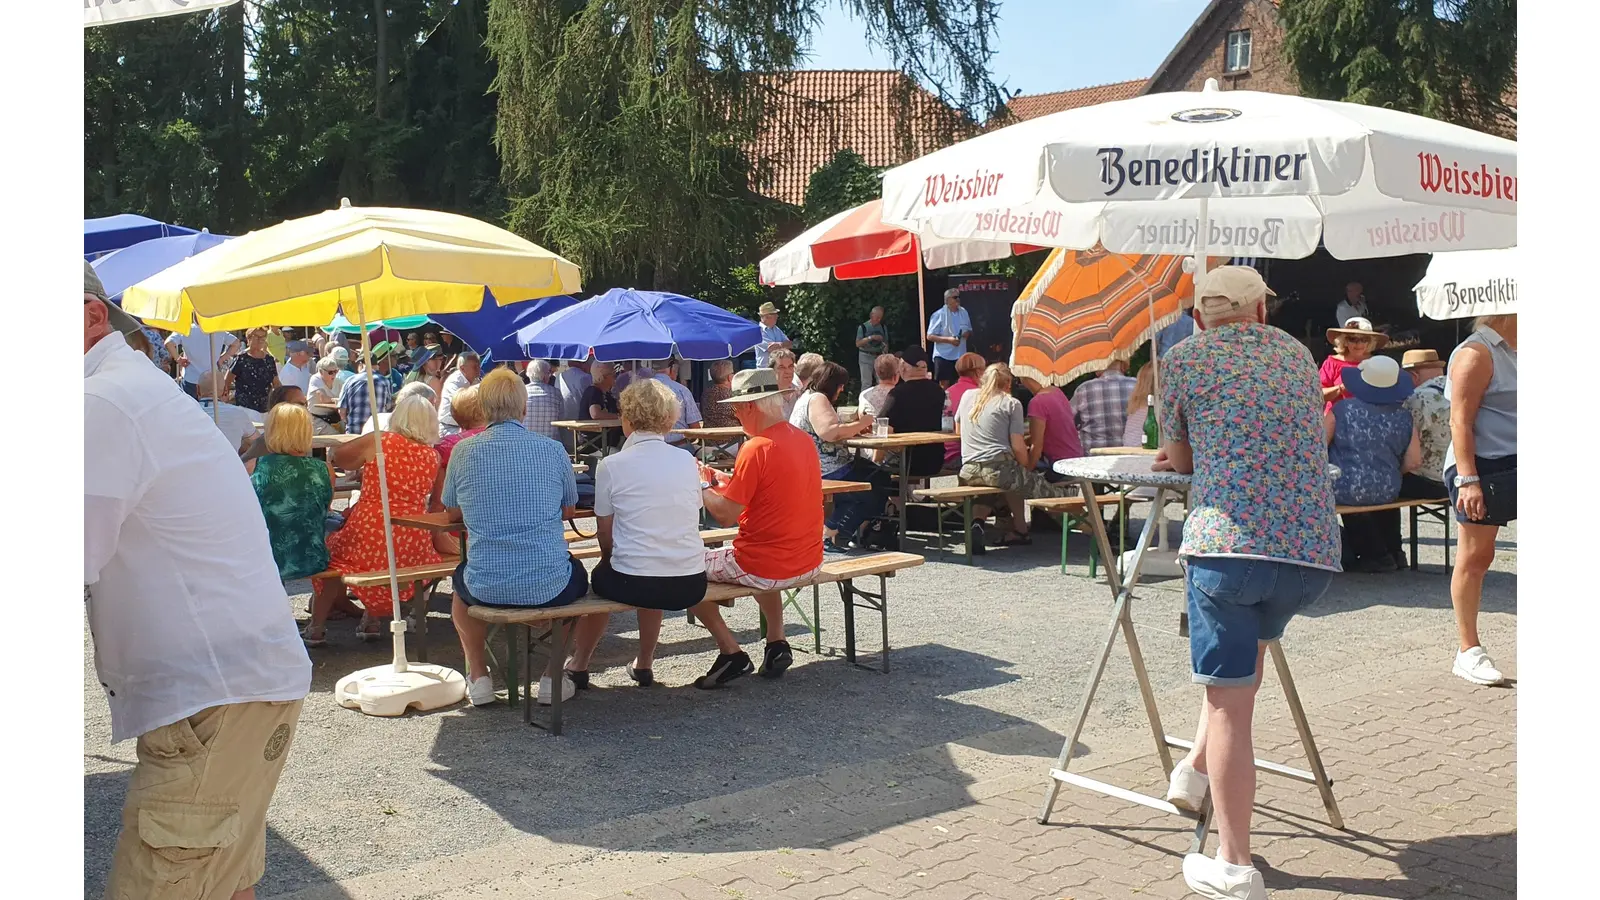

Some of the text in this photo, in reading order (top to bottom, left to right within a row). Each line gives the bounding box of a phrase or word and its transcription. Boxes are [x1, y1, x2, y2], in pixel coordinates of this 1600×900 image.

[925, 168, 1003, 207] Weissbier
[1096, 146, 1309, 196] Benediktiner
[1443, 277, 1517, 312] Benedikti
